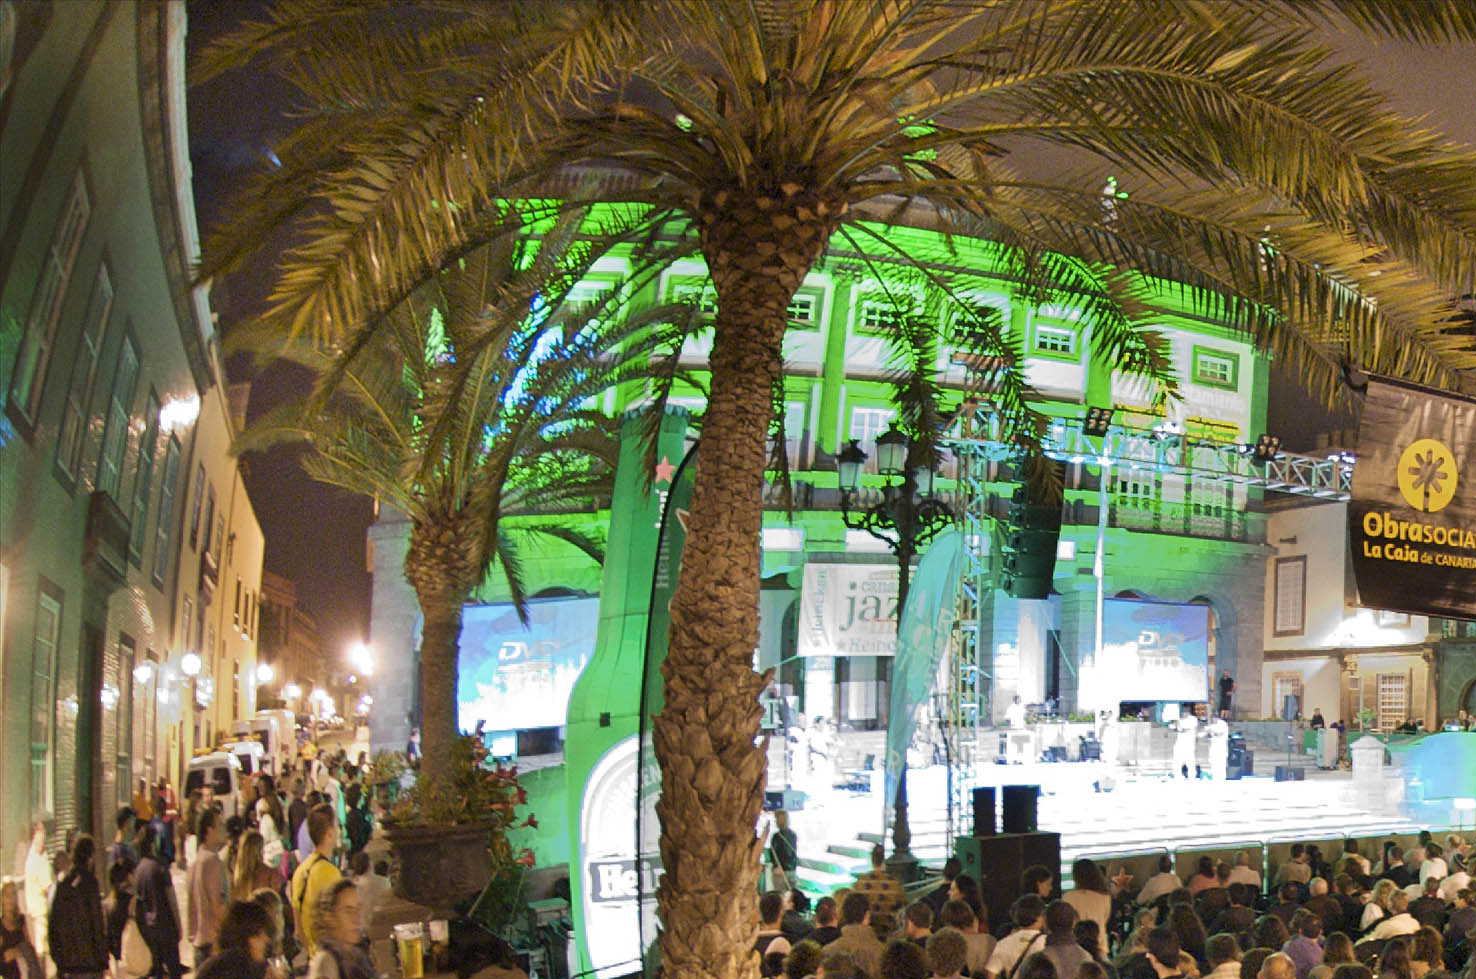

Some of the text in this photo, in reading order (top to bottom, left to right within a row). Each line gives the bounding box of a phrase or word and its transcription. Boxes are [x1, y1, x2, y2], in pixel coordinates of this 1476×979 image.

[1363, 541, 1382, 558] La
[1384, 543, 1419, 563] Caja
[1420, 552, 1433, 565] de
[839, 581, 899, 631] jaz
